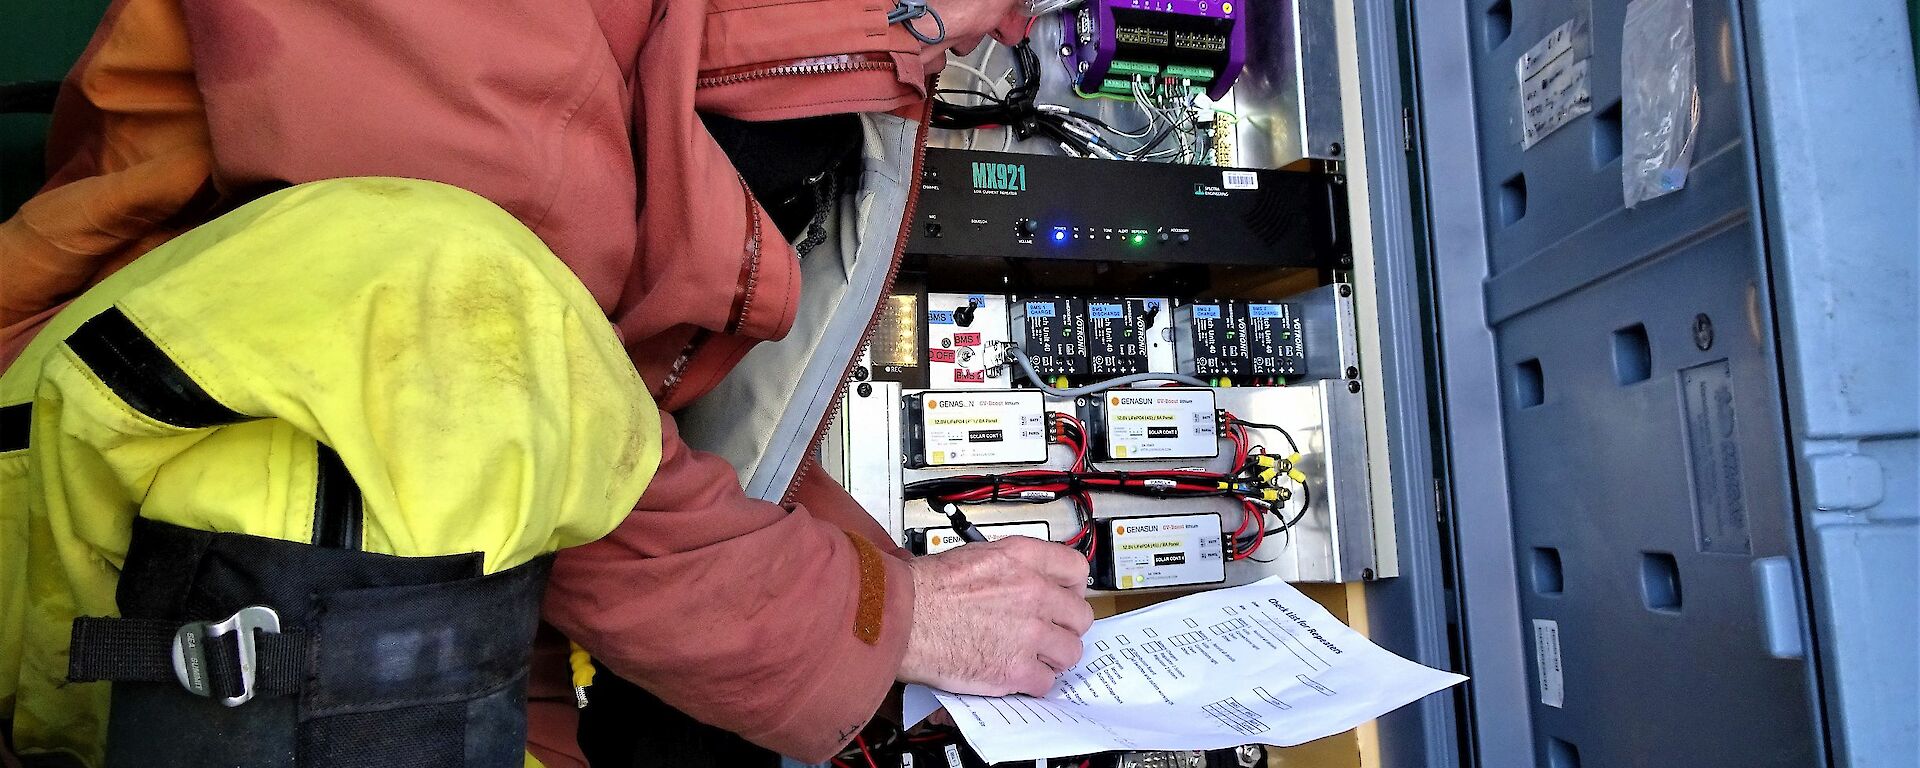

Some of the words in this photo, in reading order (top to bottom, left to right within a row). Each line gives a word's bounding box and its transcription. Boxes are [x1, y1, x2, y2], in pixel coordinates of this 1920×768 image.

[972, 162, 1026, 191] MX921
[968, 297, 983, 305] ON
[1076, 314, 1086, 357] VOTRONIC
[1137, 314, 1147, 358] VOTRONIC
[1238, 317, 1248, 359] VOTRONIC
[1293, 318, 1304, 358] VOTRONIC
[1044, 343, 1050, 352] 40
[1107, 343, 1113, 352] 40
[1210, 345, 1216, 353] 40
[1266, 345, 1272, 353] 40
[936, 352, 954, 360] OFF
[956, 370, 974, 379] BMS
[1127, 525, 1159, 533] GENASUN
[1268, 599, 1287, 612] Check
[1286, 612, 1300, 623] List
[1308, 628, 1342, 654] Repeaters
[186, 632, 195, 648] SEA
[191, 657, 202, 690] SUMMIT
